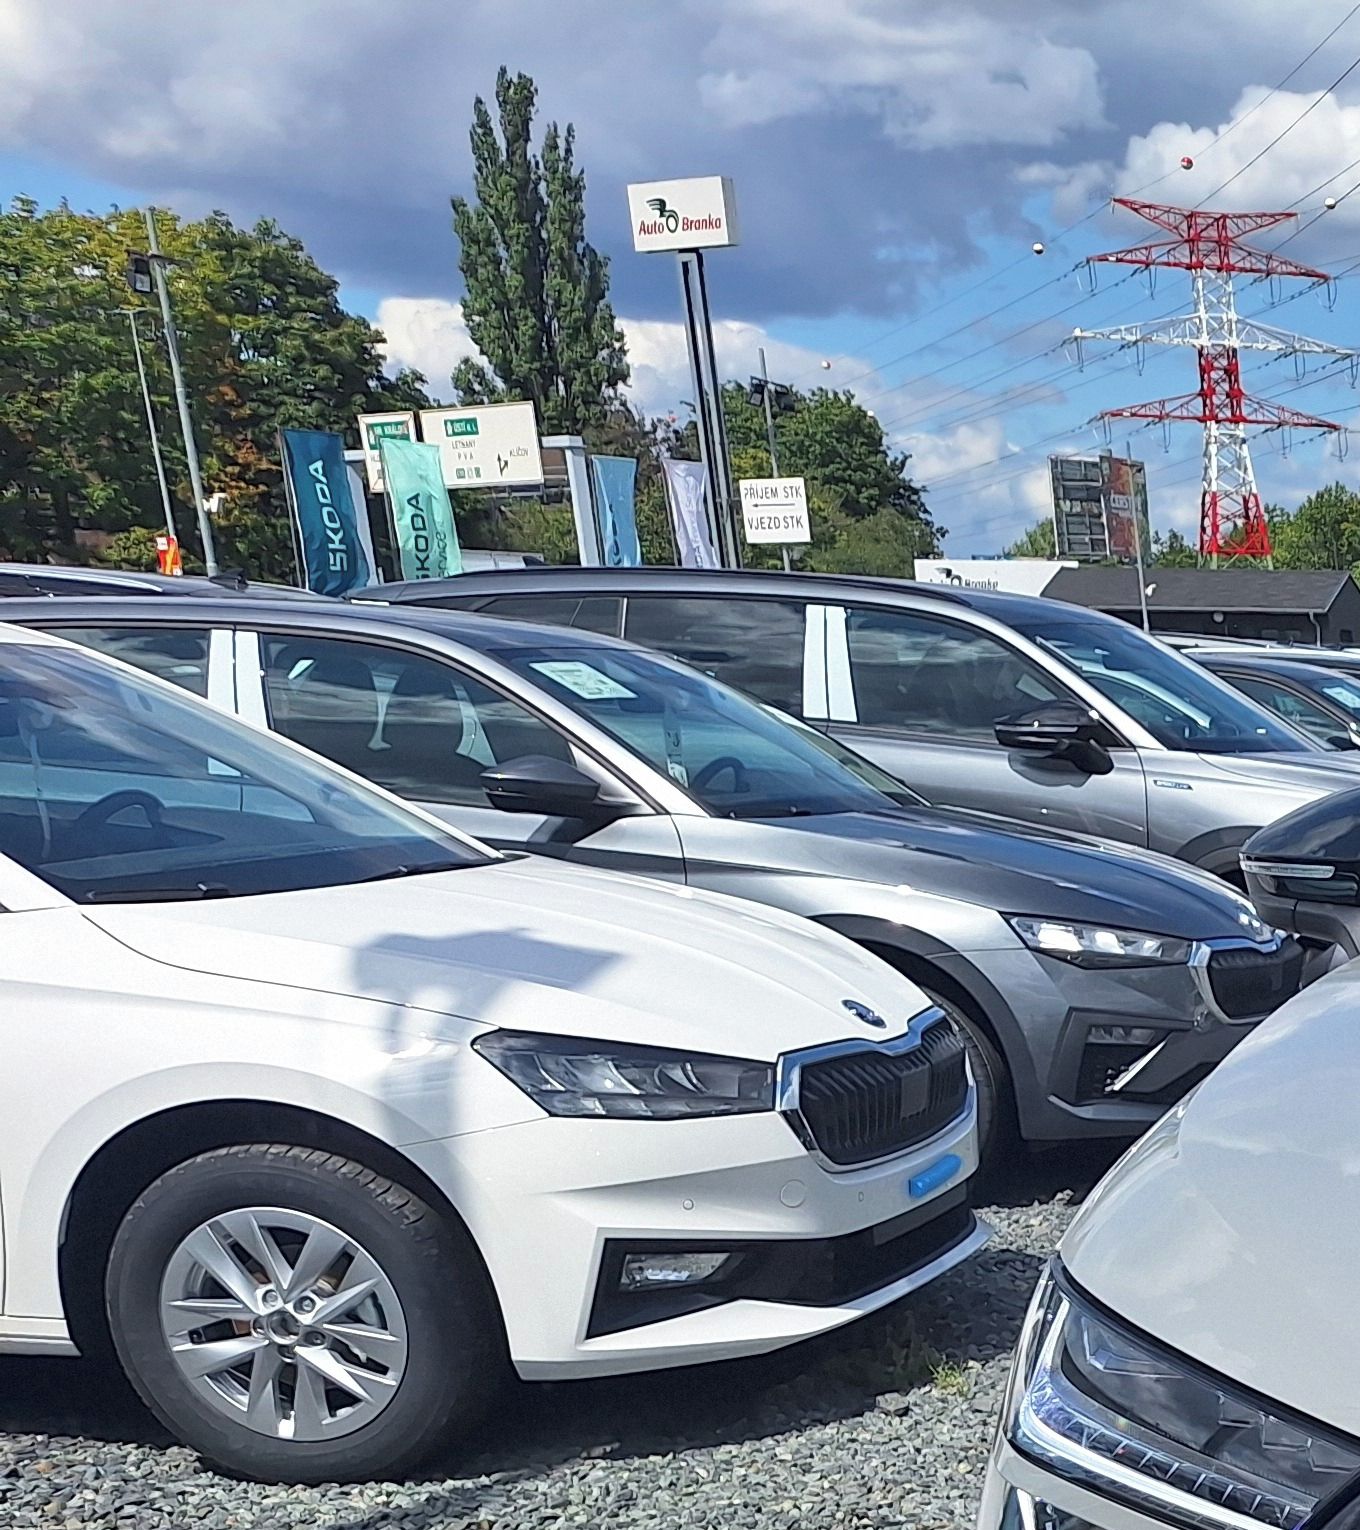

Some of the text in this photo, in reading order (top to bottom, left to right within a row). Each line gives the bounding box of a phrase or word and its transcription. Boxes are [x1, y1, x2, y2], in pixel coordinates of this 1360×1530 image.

[639, 213, 722, 236] Auto Branka
[744, 483, 802, 499] PŘÍJEM STK
[748, 515, 804, 530] VJEZD STK
